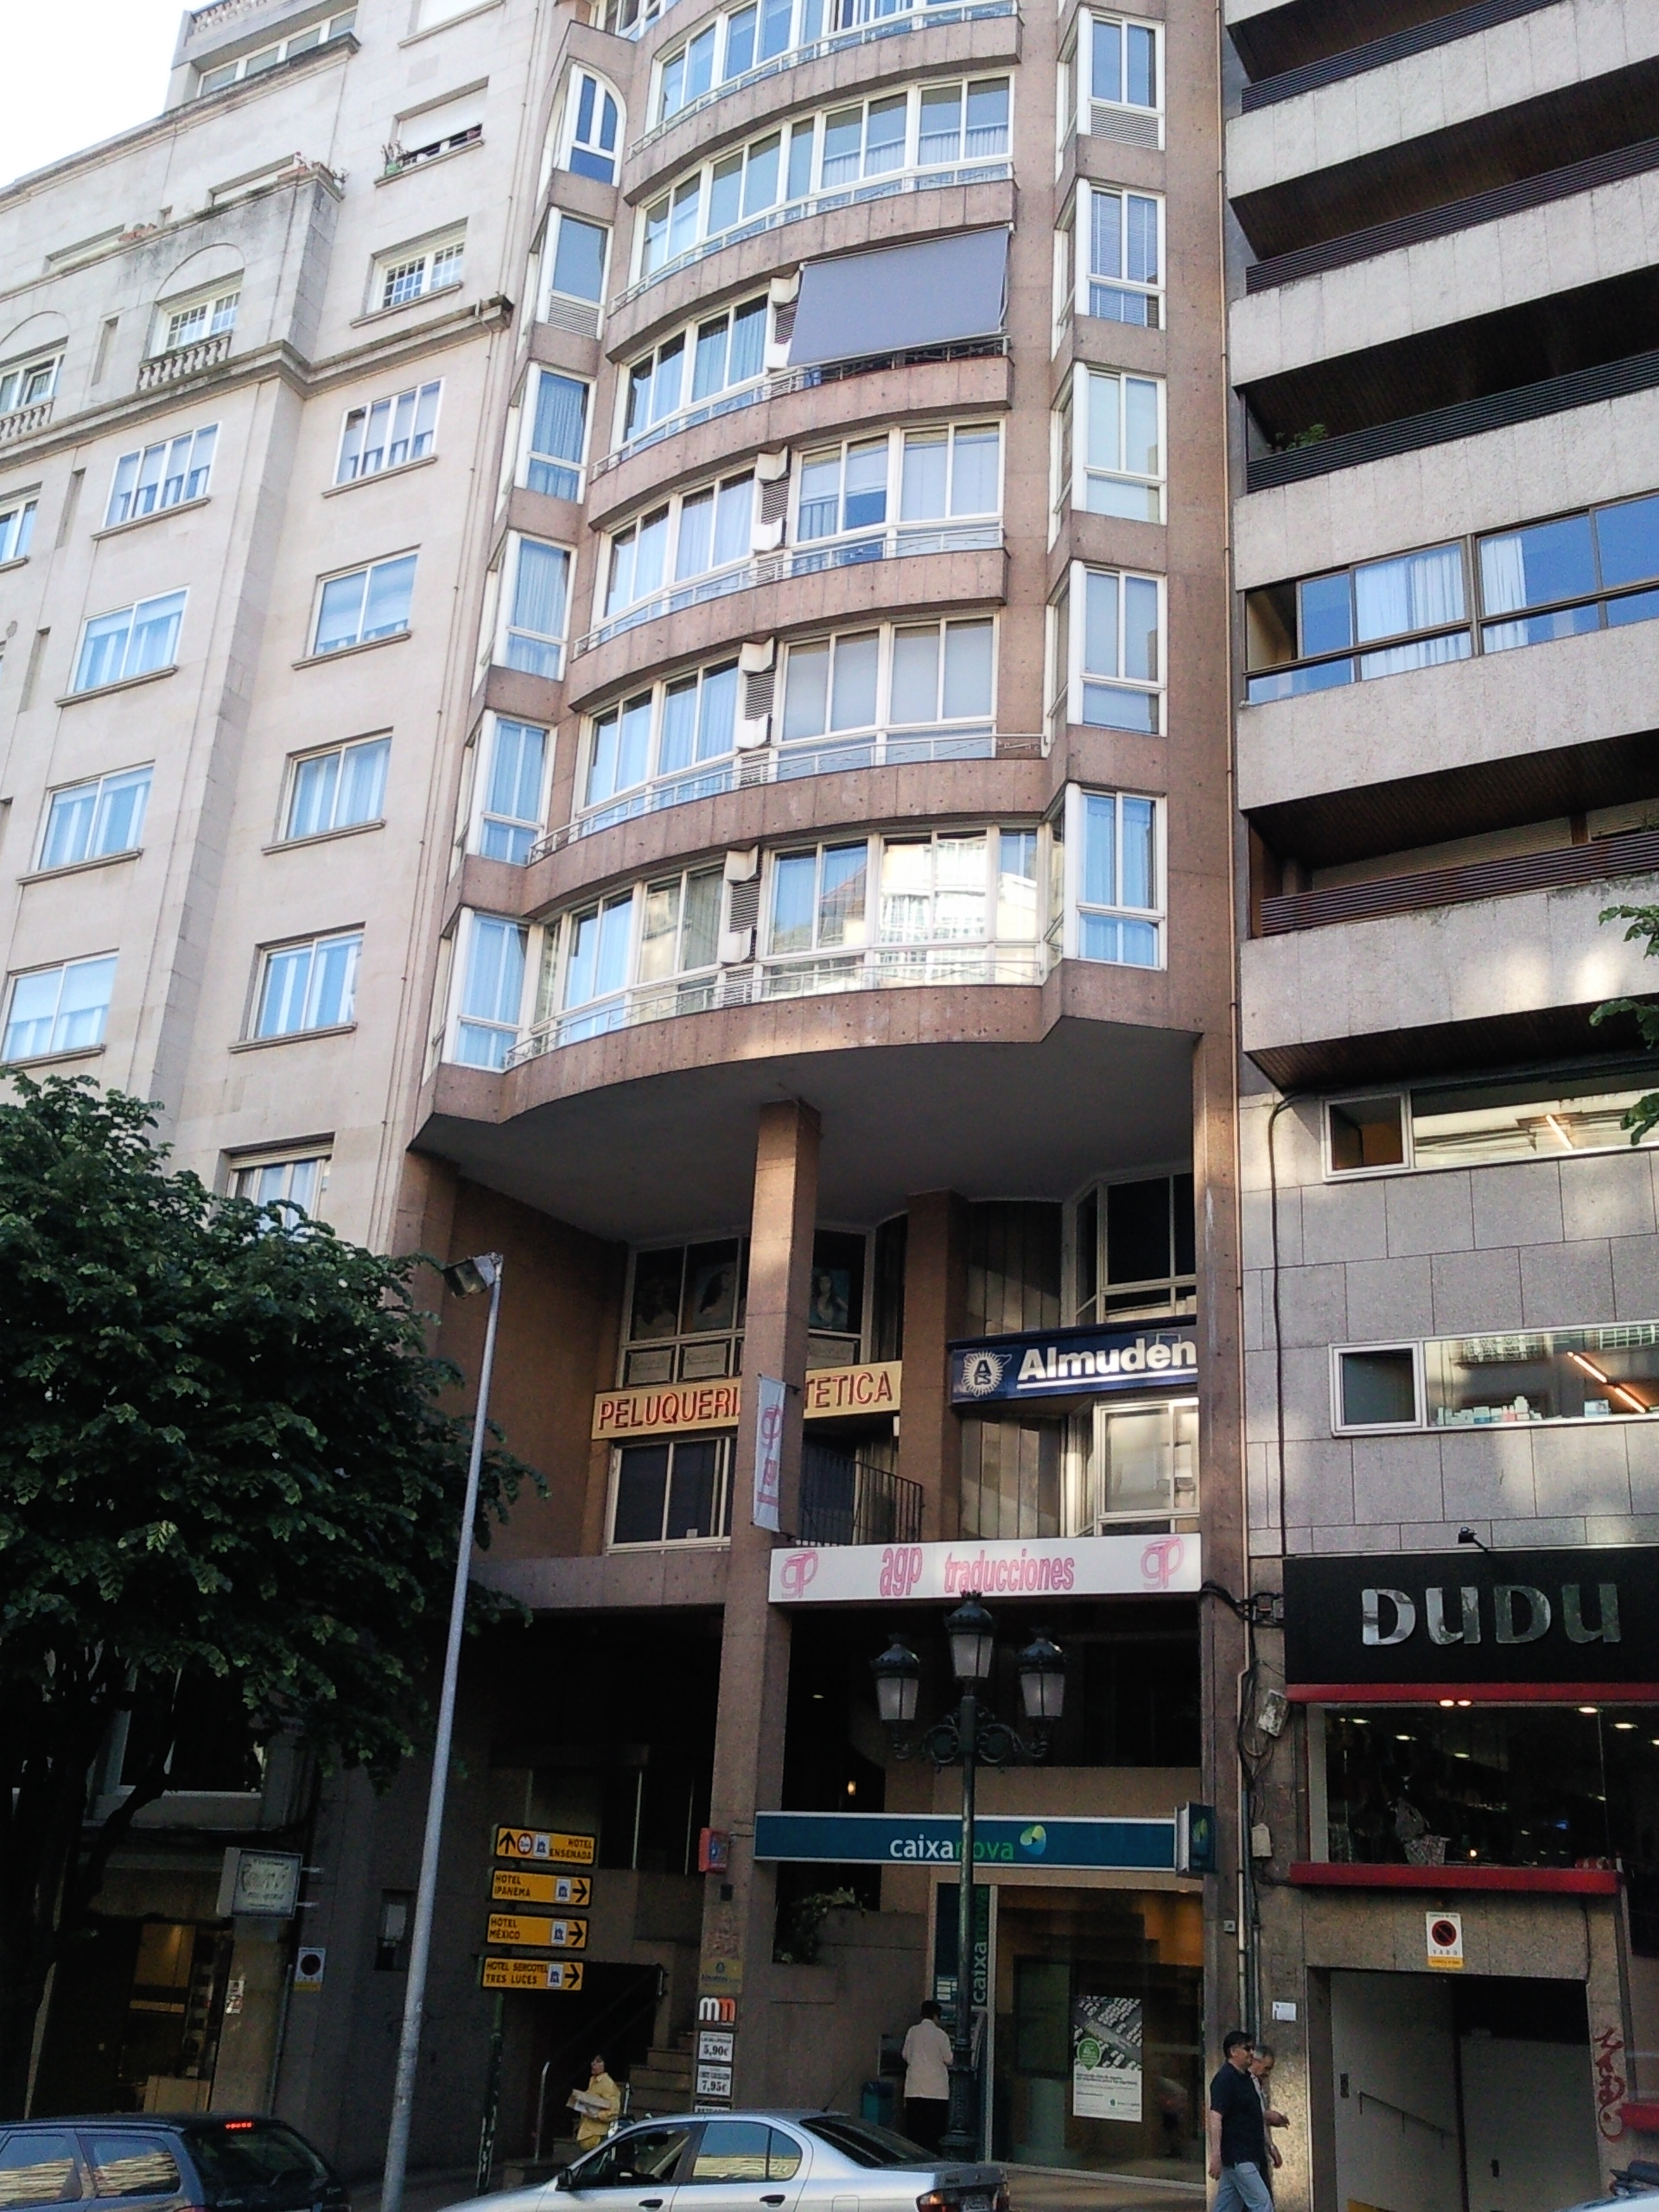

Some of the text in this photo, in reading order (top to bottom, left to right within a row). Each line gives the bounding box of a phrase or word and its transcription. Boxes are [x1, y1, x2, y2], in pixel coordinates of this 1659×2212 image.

[599, 1386, 741, 1430] PELUQUERI
[880, 1546, 923, 1597] agp
[944, 1548, 1074, 1593] traducciones
[568, 1838, 593, 1849] HOTEL
[550, 1848, 592, 1859] ENSENADA
[495, 1874, 521, 1885] HOTEL
[494, 1886, 531, 1897] IPANEMA
[491, 1918, 517, 1928] HOTEL
[489, 1929, 520, 1940] MÉXICO
[487, 1961, 509, 1971] HOTEL
[486, 1974, 537, 1985] TRES LUCES
